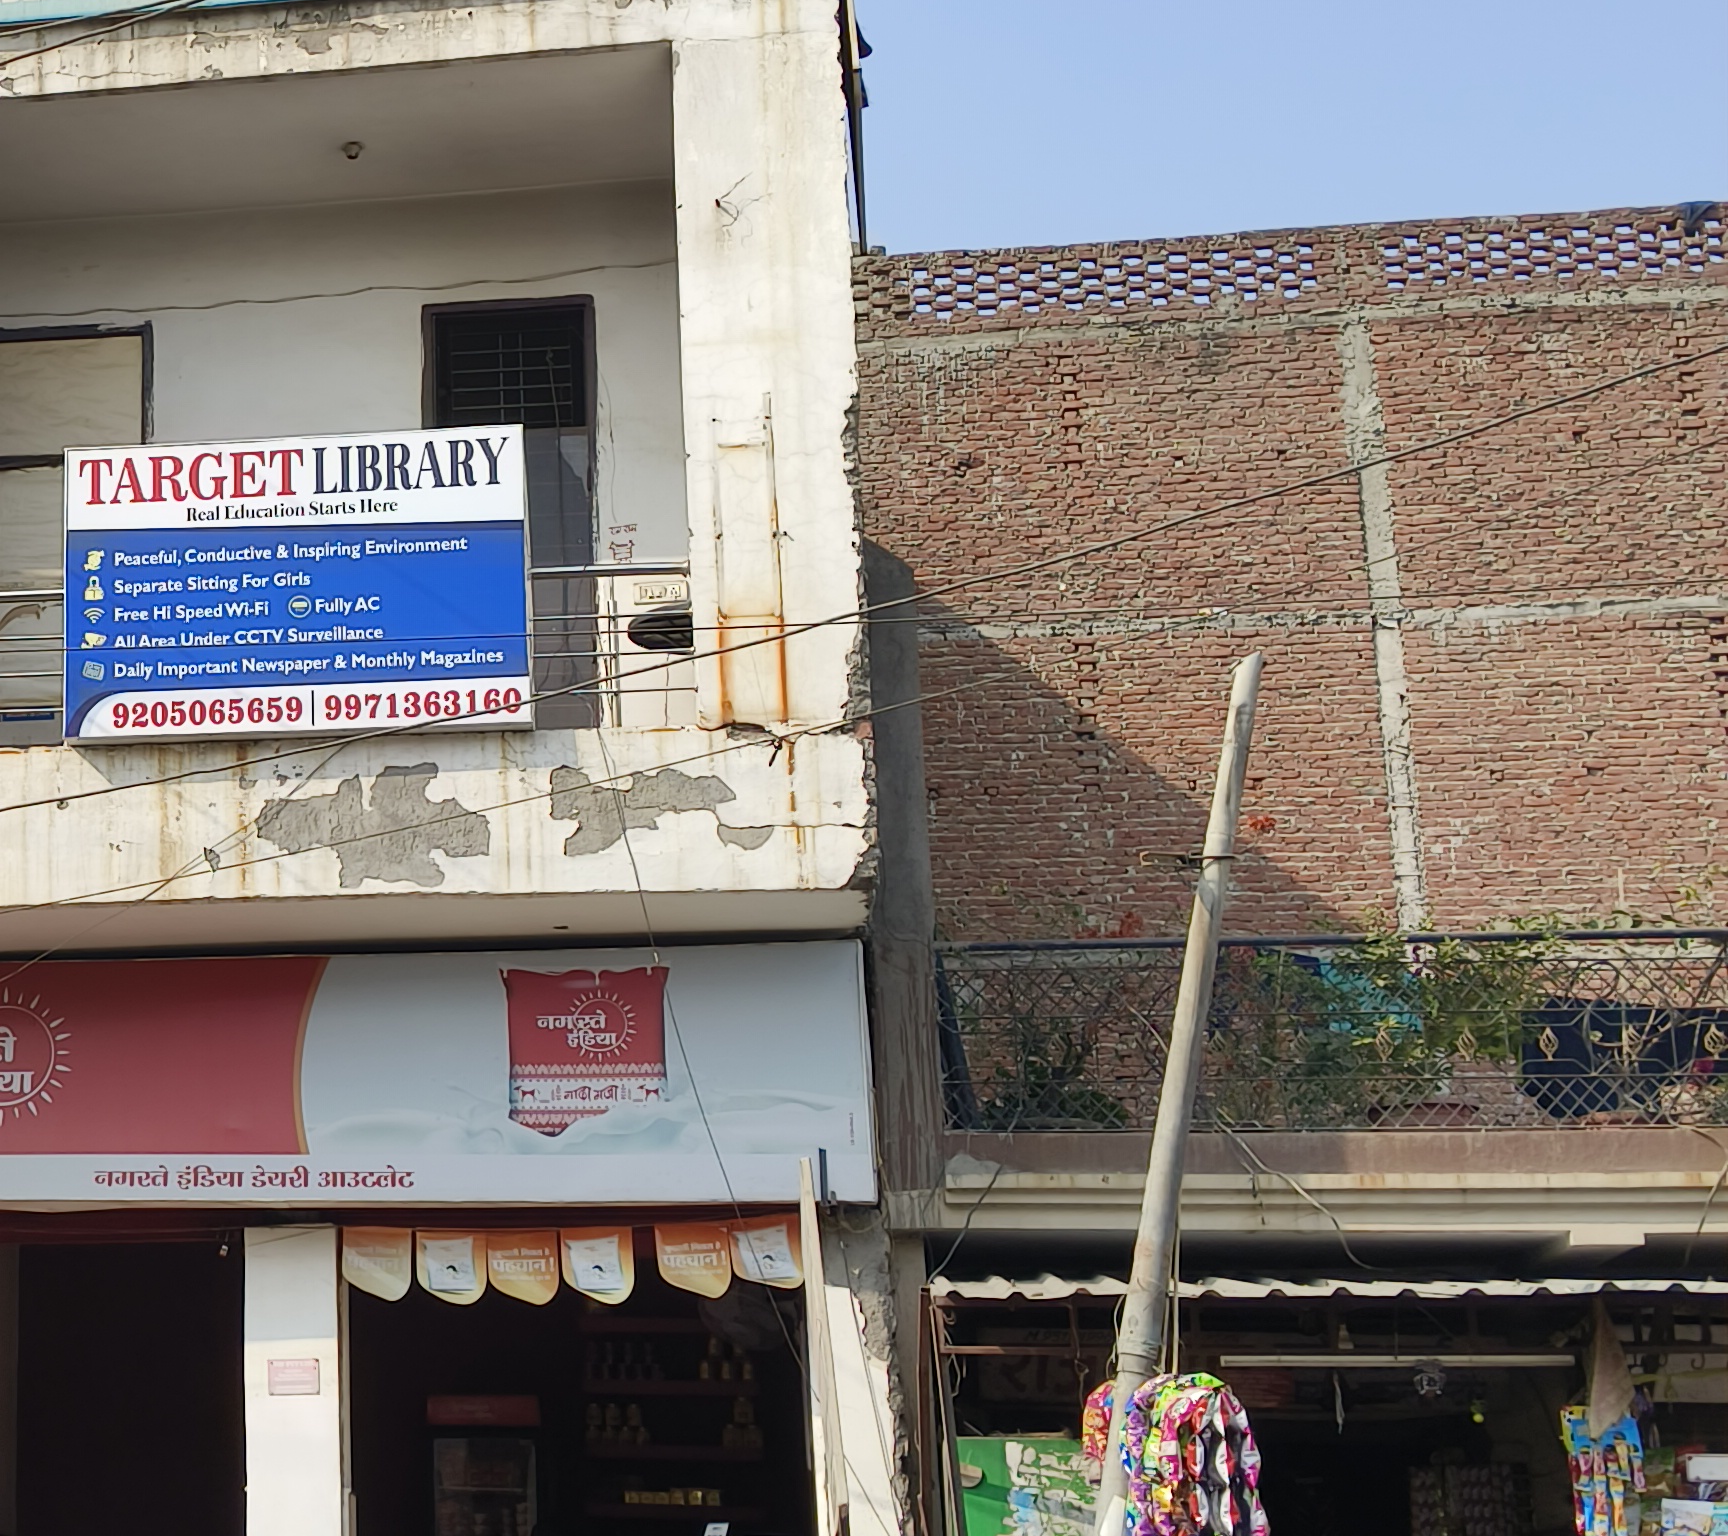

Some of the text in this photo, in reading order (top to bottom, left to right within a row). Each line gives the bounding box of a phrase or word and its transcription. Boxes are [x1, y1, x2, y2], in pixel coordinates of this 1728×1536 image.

[78, 437, 510, 505] TARGET LIBRARY
[186, 498, 399, 523] Real Education Starts Here
[113, 536, 469, 569] Peaceful, Conductive & Inspiring Environment
[113, 570, 312, 597] Separate Sitting For Girls
[112, 687, 523, 730] 9205065659 9971363160
[176, 1164, 244, 1190] इंडिया
[251, 1164, 311, 1189] डेयरी
[317, 1164, 415, 1189] आउटलेट
